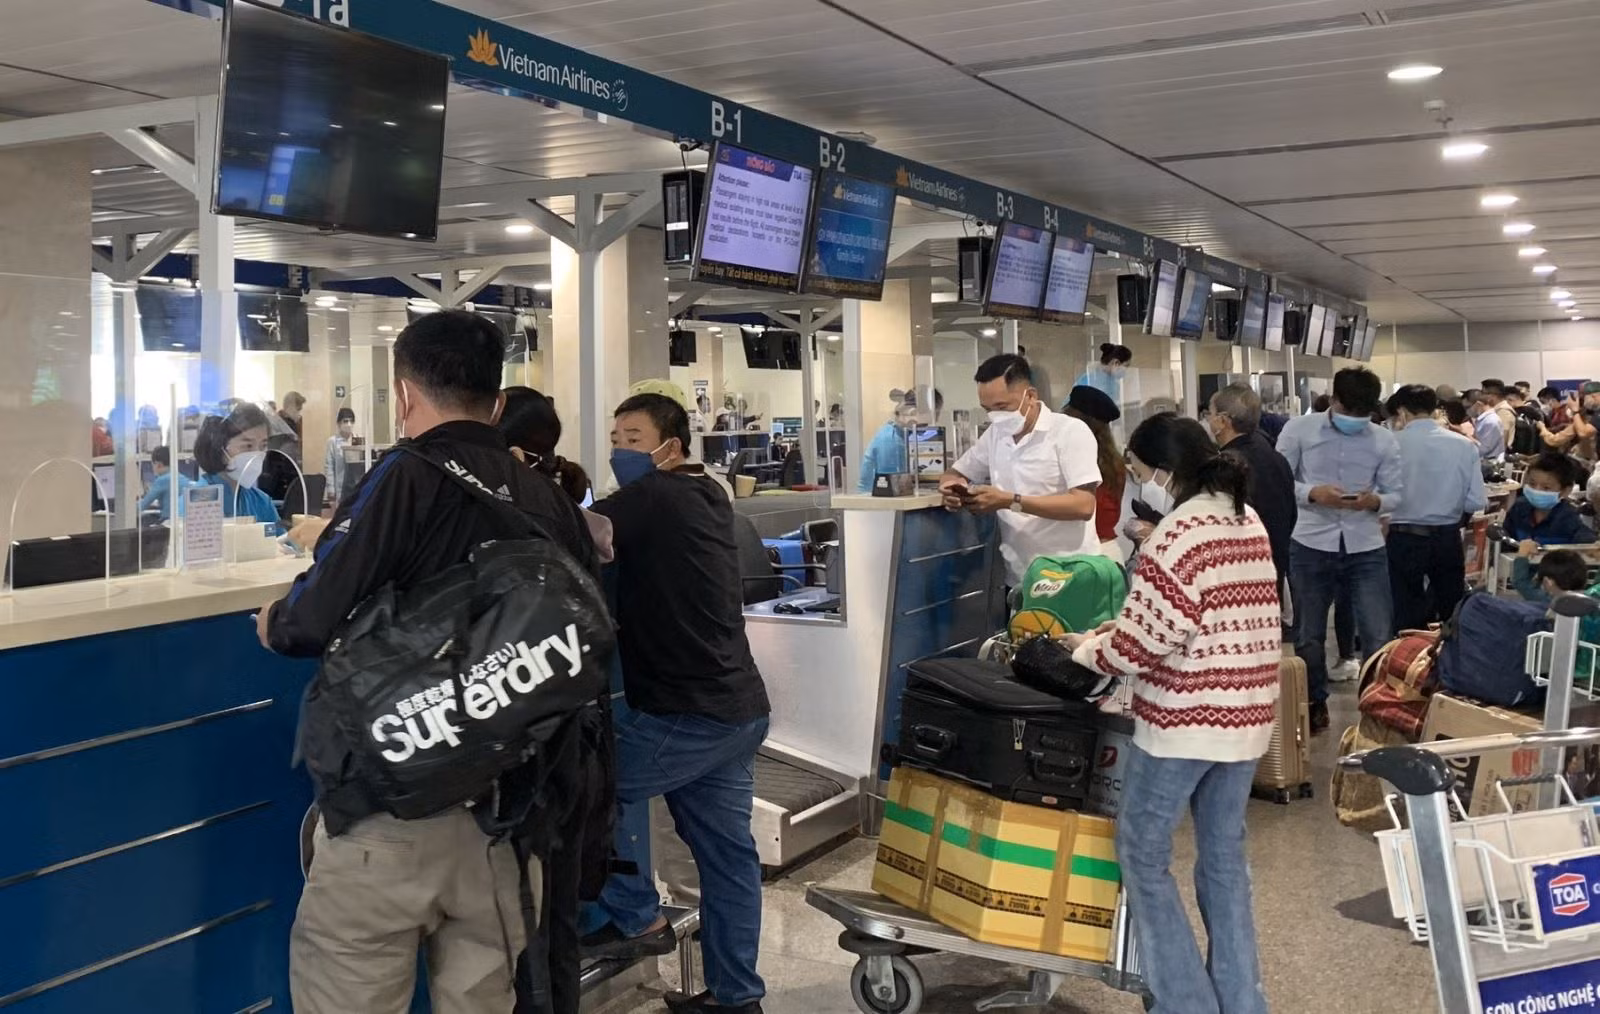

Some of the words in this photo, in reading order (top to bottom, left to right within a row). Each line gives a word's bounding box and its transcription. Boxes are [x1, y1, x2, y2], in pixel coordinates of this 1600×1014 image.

[711, 100, 743, 143] B-1
[819, 135, 846, 173] B-2
[996, 191, 1014, 220] B-3
[1044, 205, 1059, 232] B-4
[1553, 884, 1586, 905] TOA
[1517, 994, 1557, 1014] CÔNG
[1557, 982, 1596, 1008] NGHỆ
